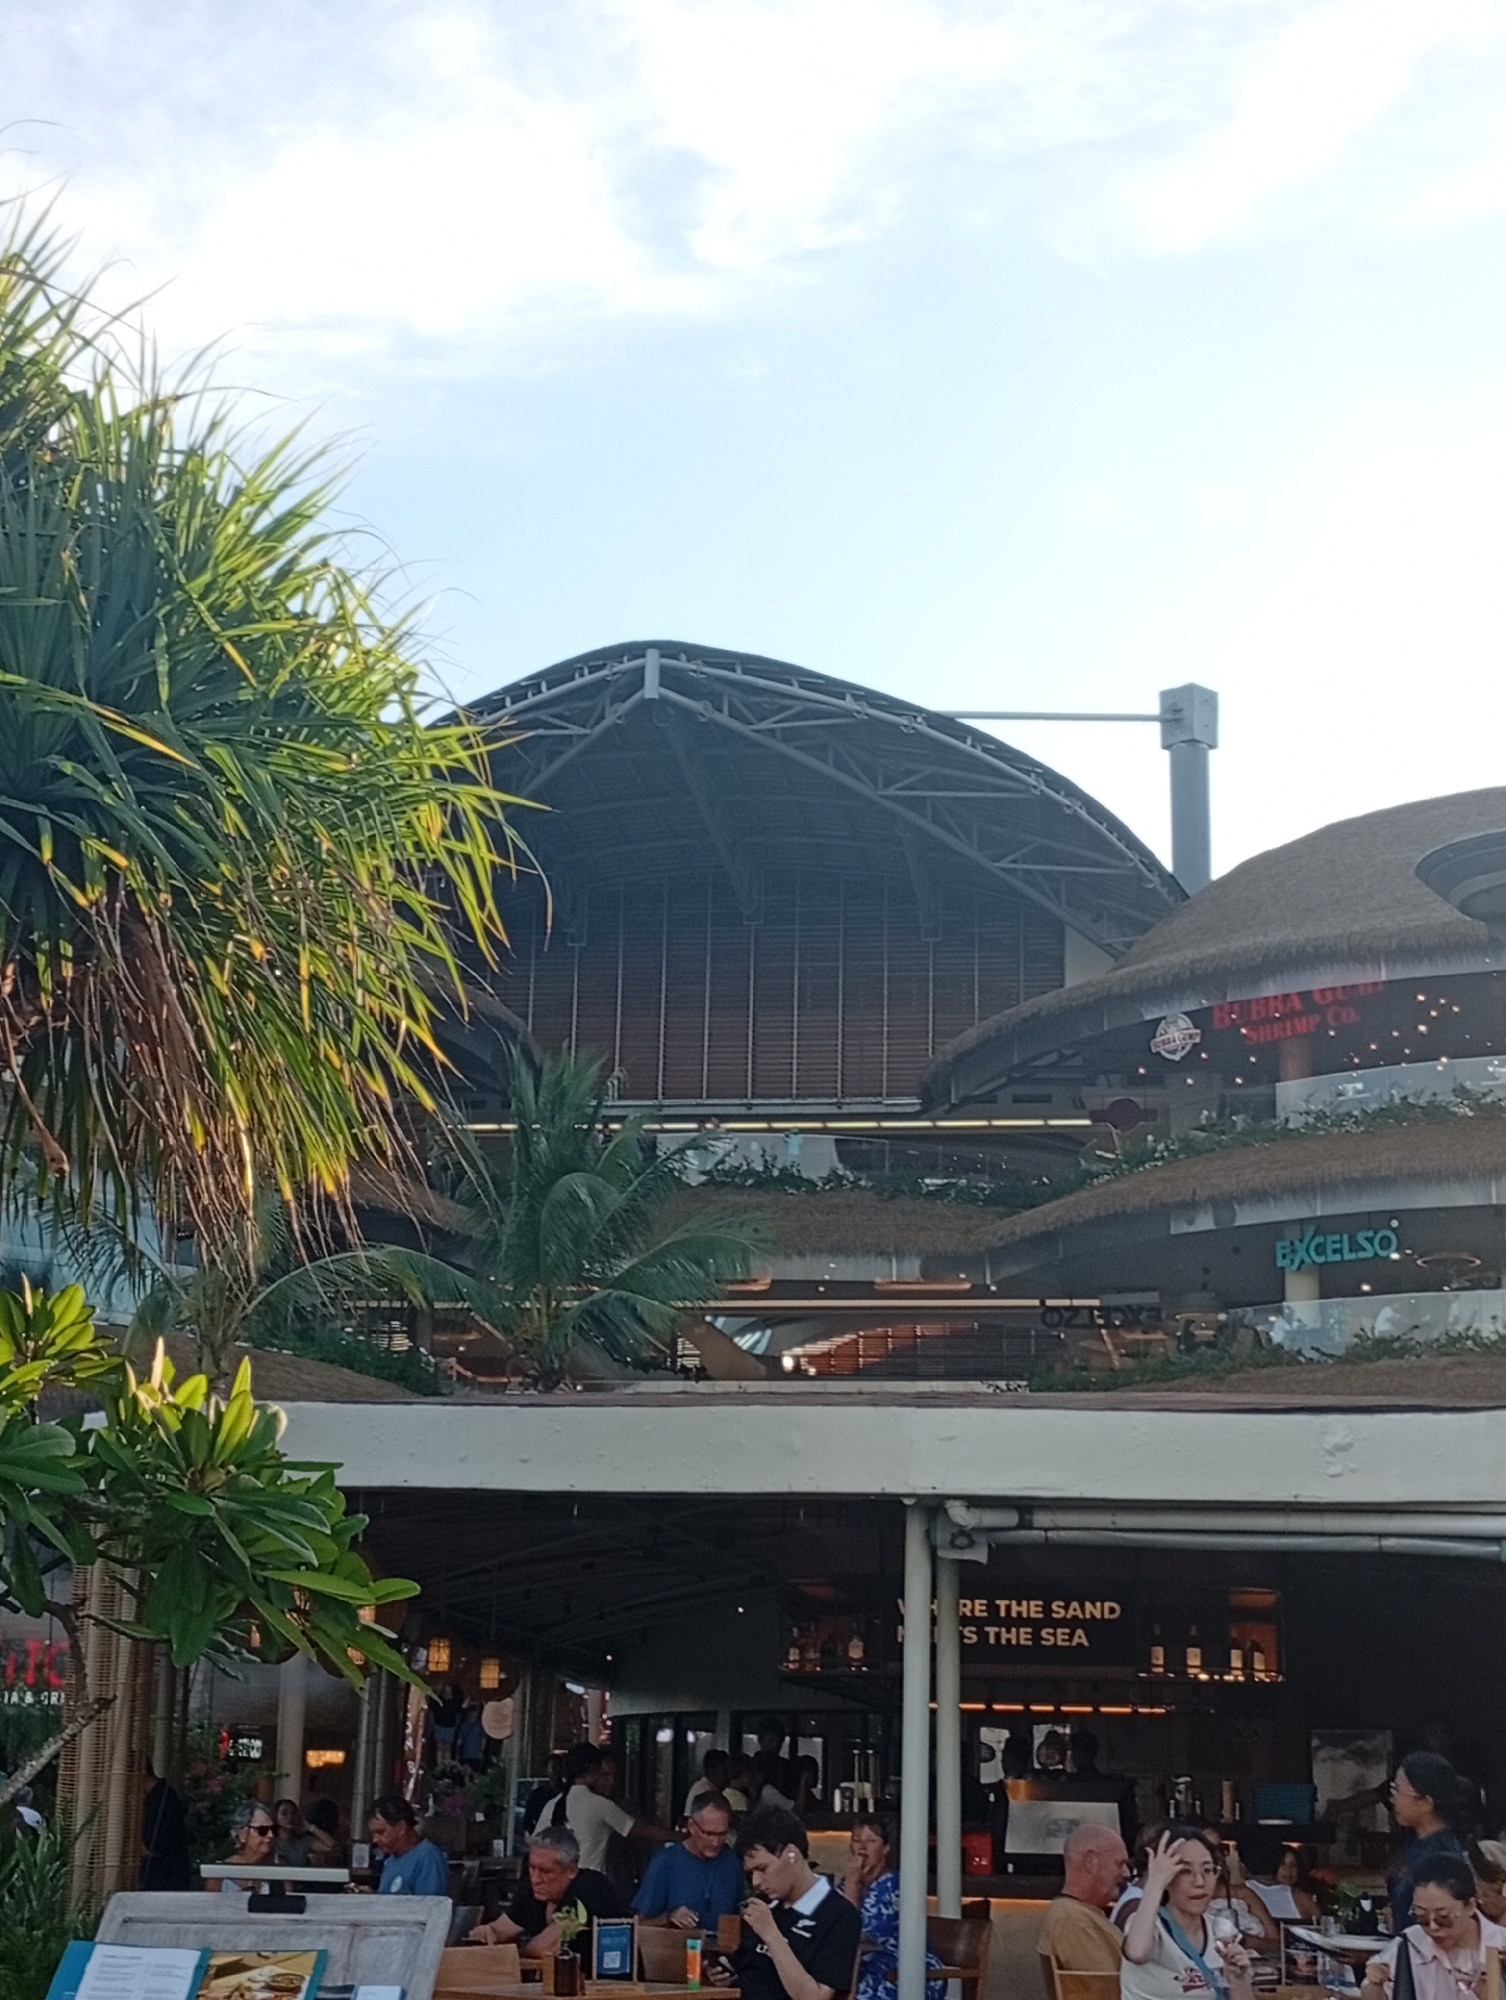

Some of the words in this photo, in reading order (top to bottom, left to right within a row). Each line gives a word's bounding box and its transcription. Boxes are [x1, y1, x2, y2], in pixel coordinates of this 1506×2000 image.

[1212, 993, 1303, 1031] BUBBA
[1245, 1014, 1321, 1045] SHRIMP
[1276, 1225, 1397, 1271] EXCELSO
[995, 1599, 1043, 1618] THE
[1051, 1601, 1121, 1619] SAND
[984, 1626, 1032, 1645] THE
[1040, 1628, 1089, 1647] SEA
